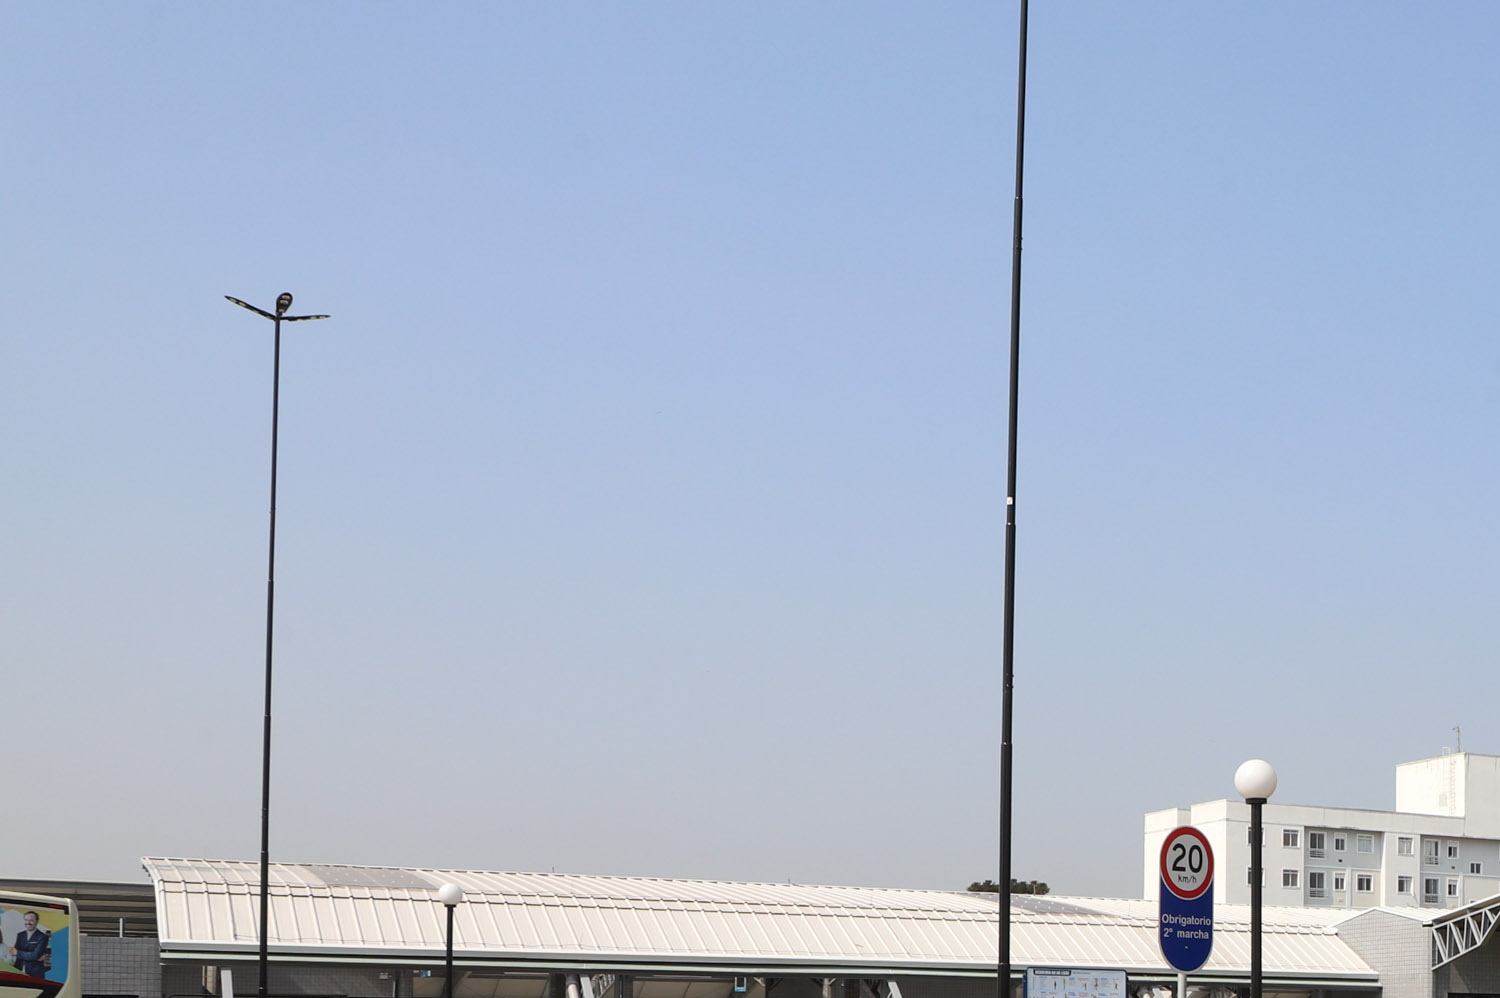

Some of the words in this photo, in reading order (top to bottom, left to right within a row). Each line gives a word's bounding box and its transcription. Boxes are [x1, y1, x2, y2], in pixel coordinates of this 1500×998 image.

[1172, 843, 1203, 873] 20
[1178, 874, 1197, 883] km/h
[1161, 914, 1211, 927] Obrigatorio
[1177, 929, 1209, 939] marcha
